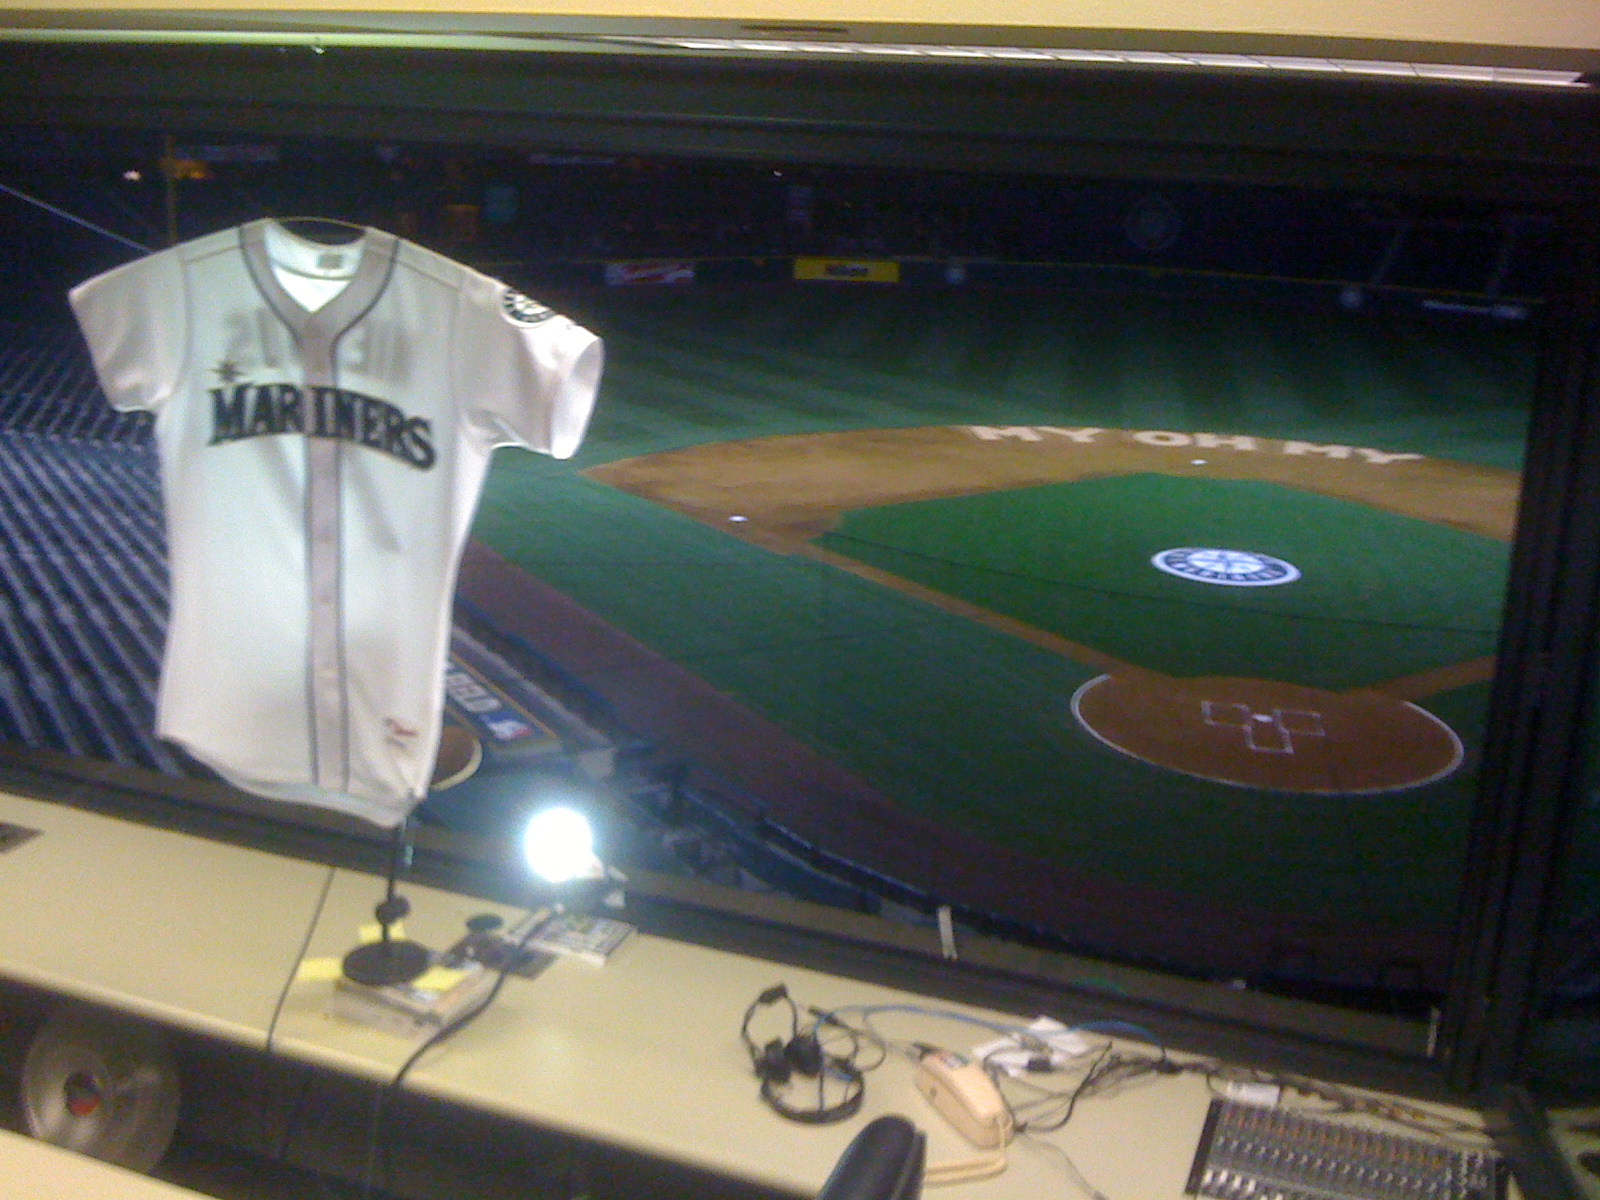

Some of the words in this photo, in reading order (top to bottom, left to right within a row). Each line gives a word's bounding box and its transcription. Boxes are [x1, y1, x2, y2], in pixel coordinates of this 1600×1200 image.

[207, 382, 437, 471] MARINERS
[968, 425, 1104, 443] MY
[1132, 430, 1257, 450] OH
[1283, 440, 1425, 464] MY
